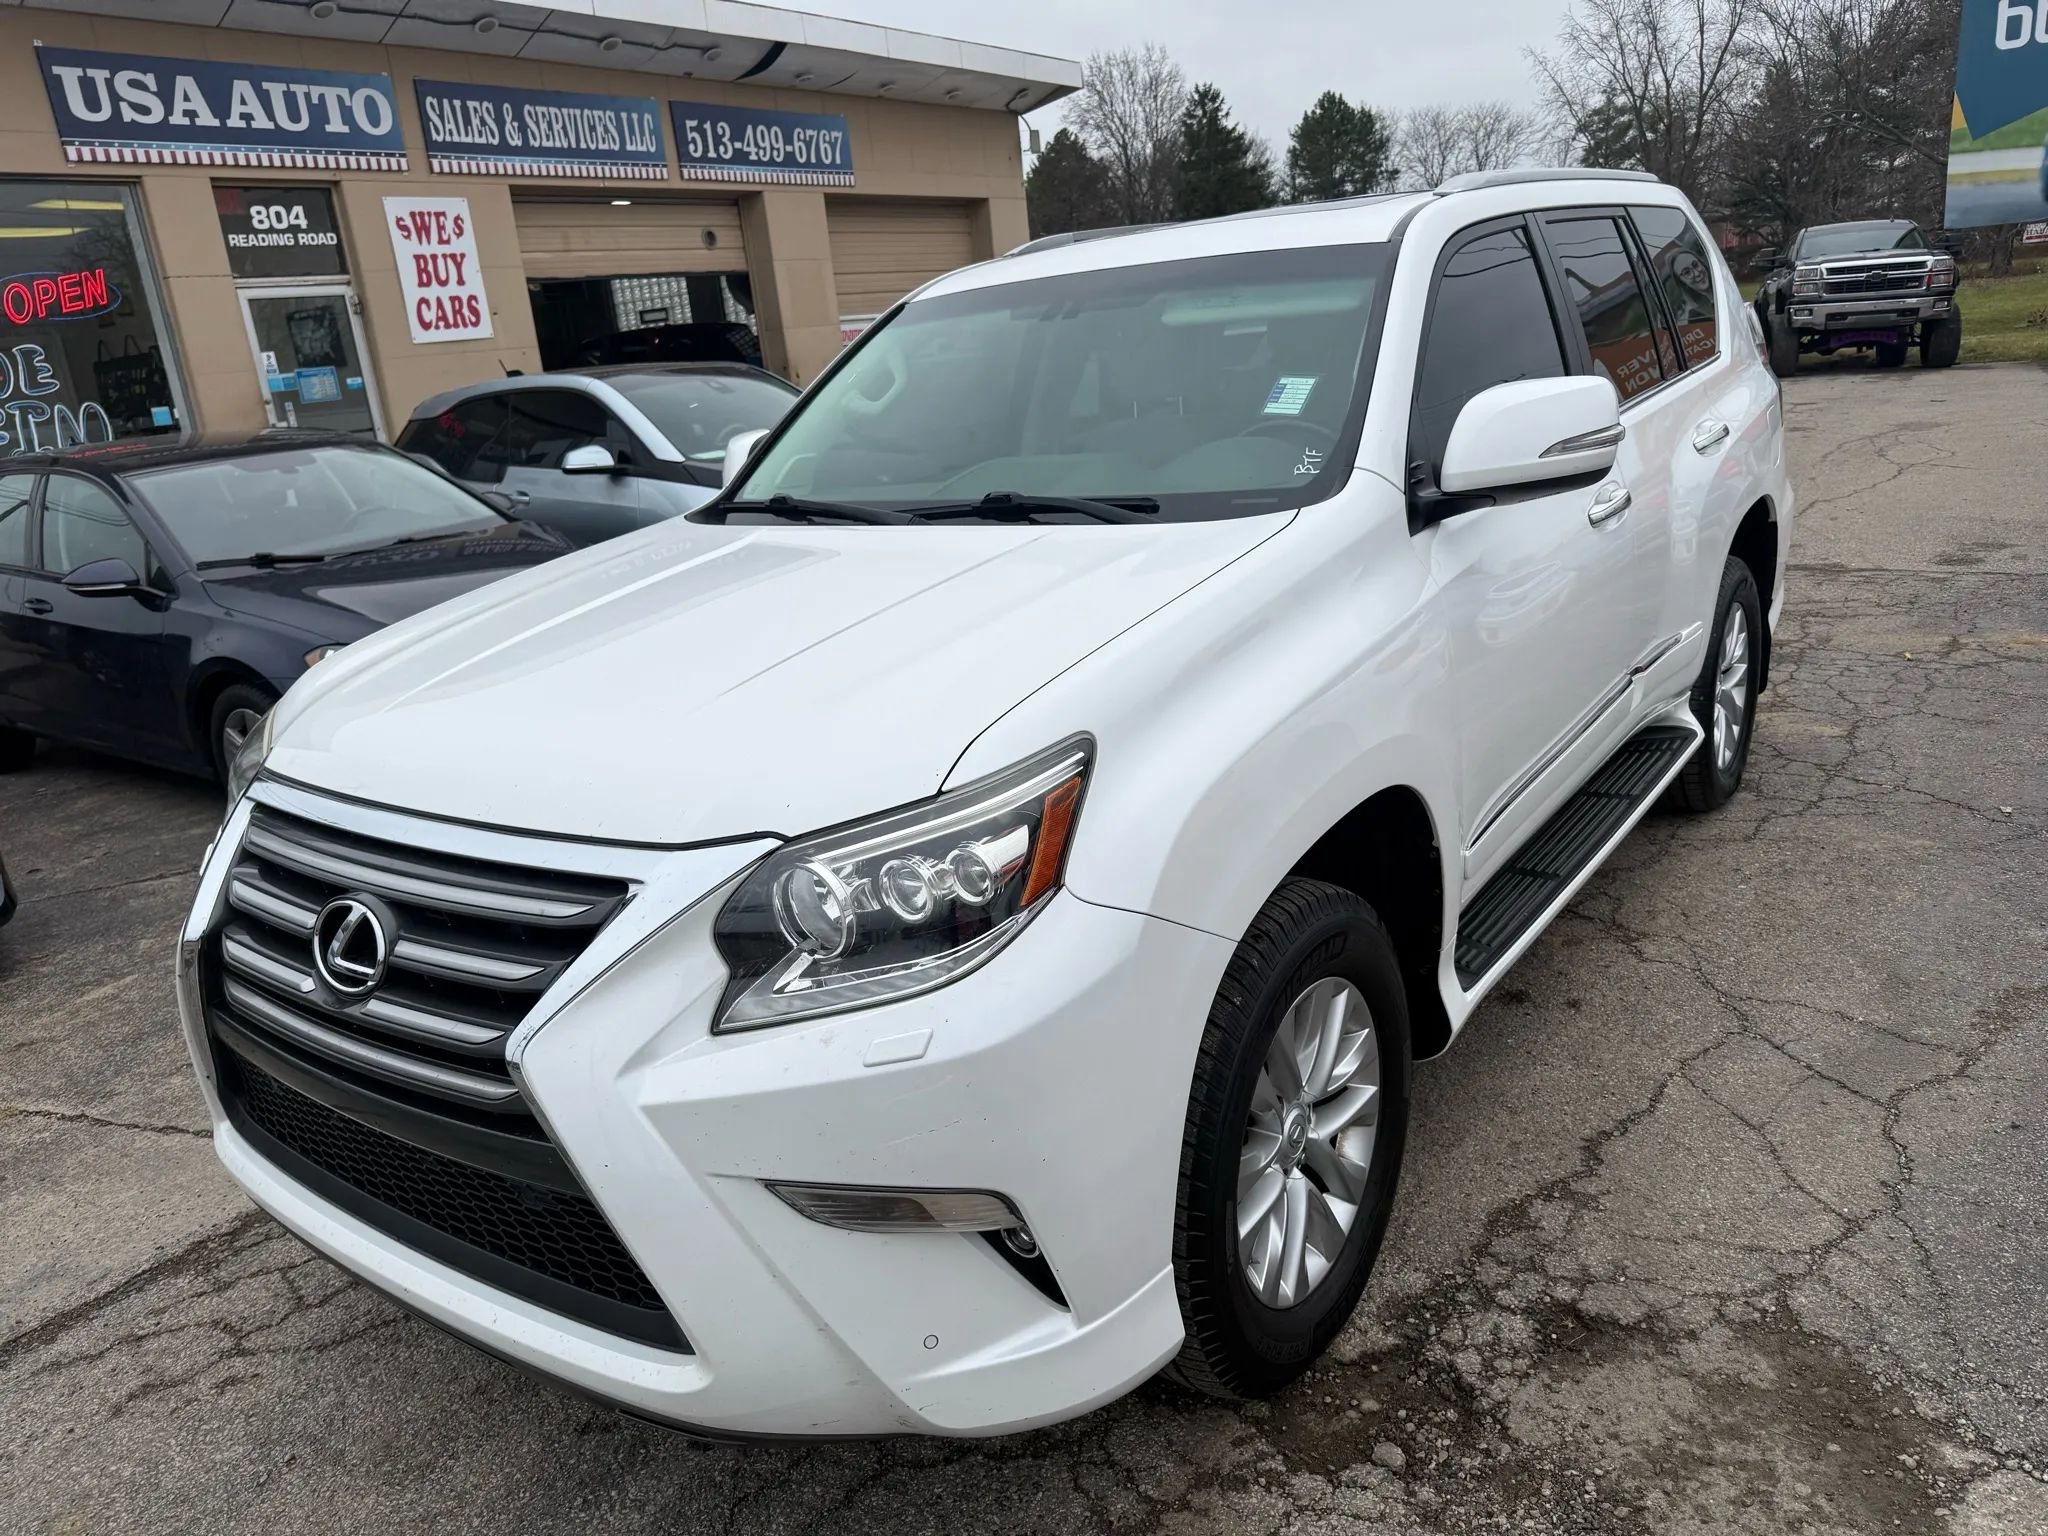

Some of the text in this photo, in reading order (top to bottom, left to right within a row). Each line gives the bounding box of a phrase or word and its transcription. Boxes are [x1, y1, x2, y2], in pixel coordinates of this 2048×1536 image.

[52, 65, 393, 136] USA AUTO
[425, 96, 657, 153] SALES & SERVICES LLC
[685, 119, 843, 165] 513-499-6767
[249, 205, 309, 230] 804
[228, 232, 338, 247] READING ROAD
[413, 252, 466, 288] BUY
[3, 268, 108, 325] OPEN
[416, 294, 482, 332] CARS
